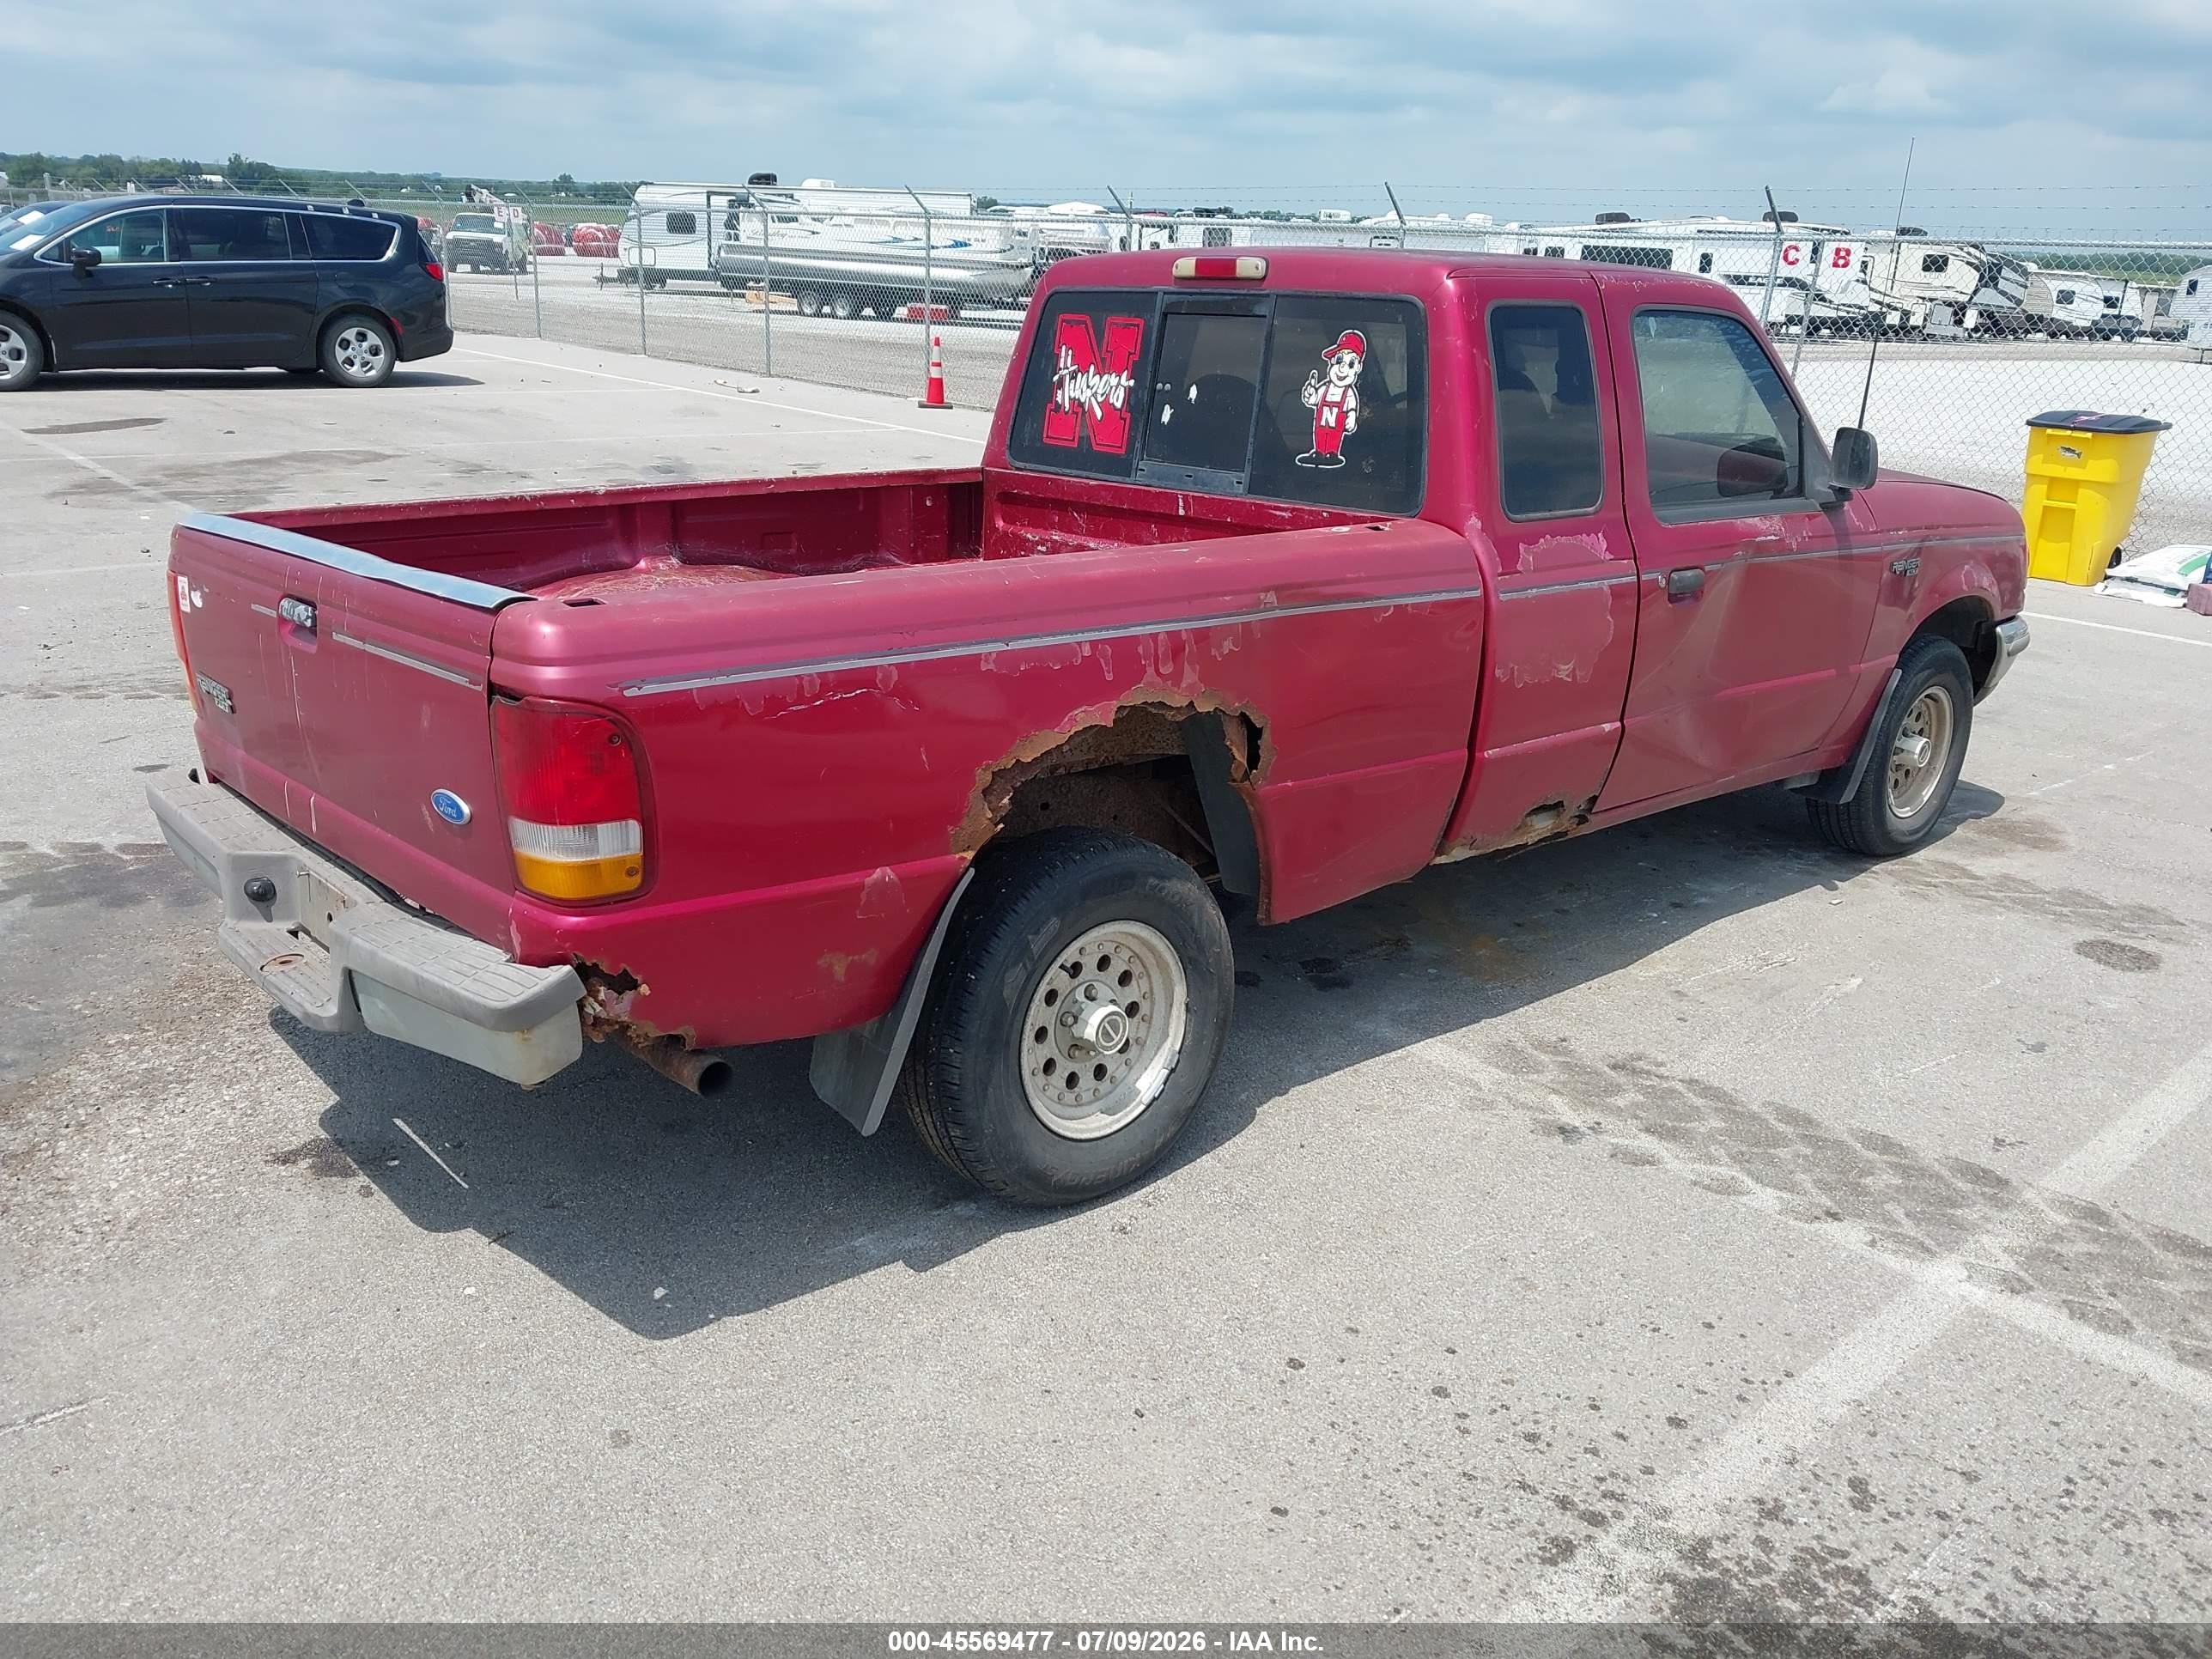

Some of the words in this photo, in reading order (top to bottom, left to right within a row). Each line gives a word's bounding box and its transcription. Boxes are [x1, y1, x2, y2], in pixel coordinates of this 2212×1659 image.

[1783, 245, 1801, 265] C
[1832, 247, 1851, 268] B
[1043, 313, 1145, 454] N
[1321, 406, 1338, 428] N
[438, 796, 458, 818] Ford
